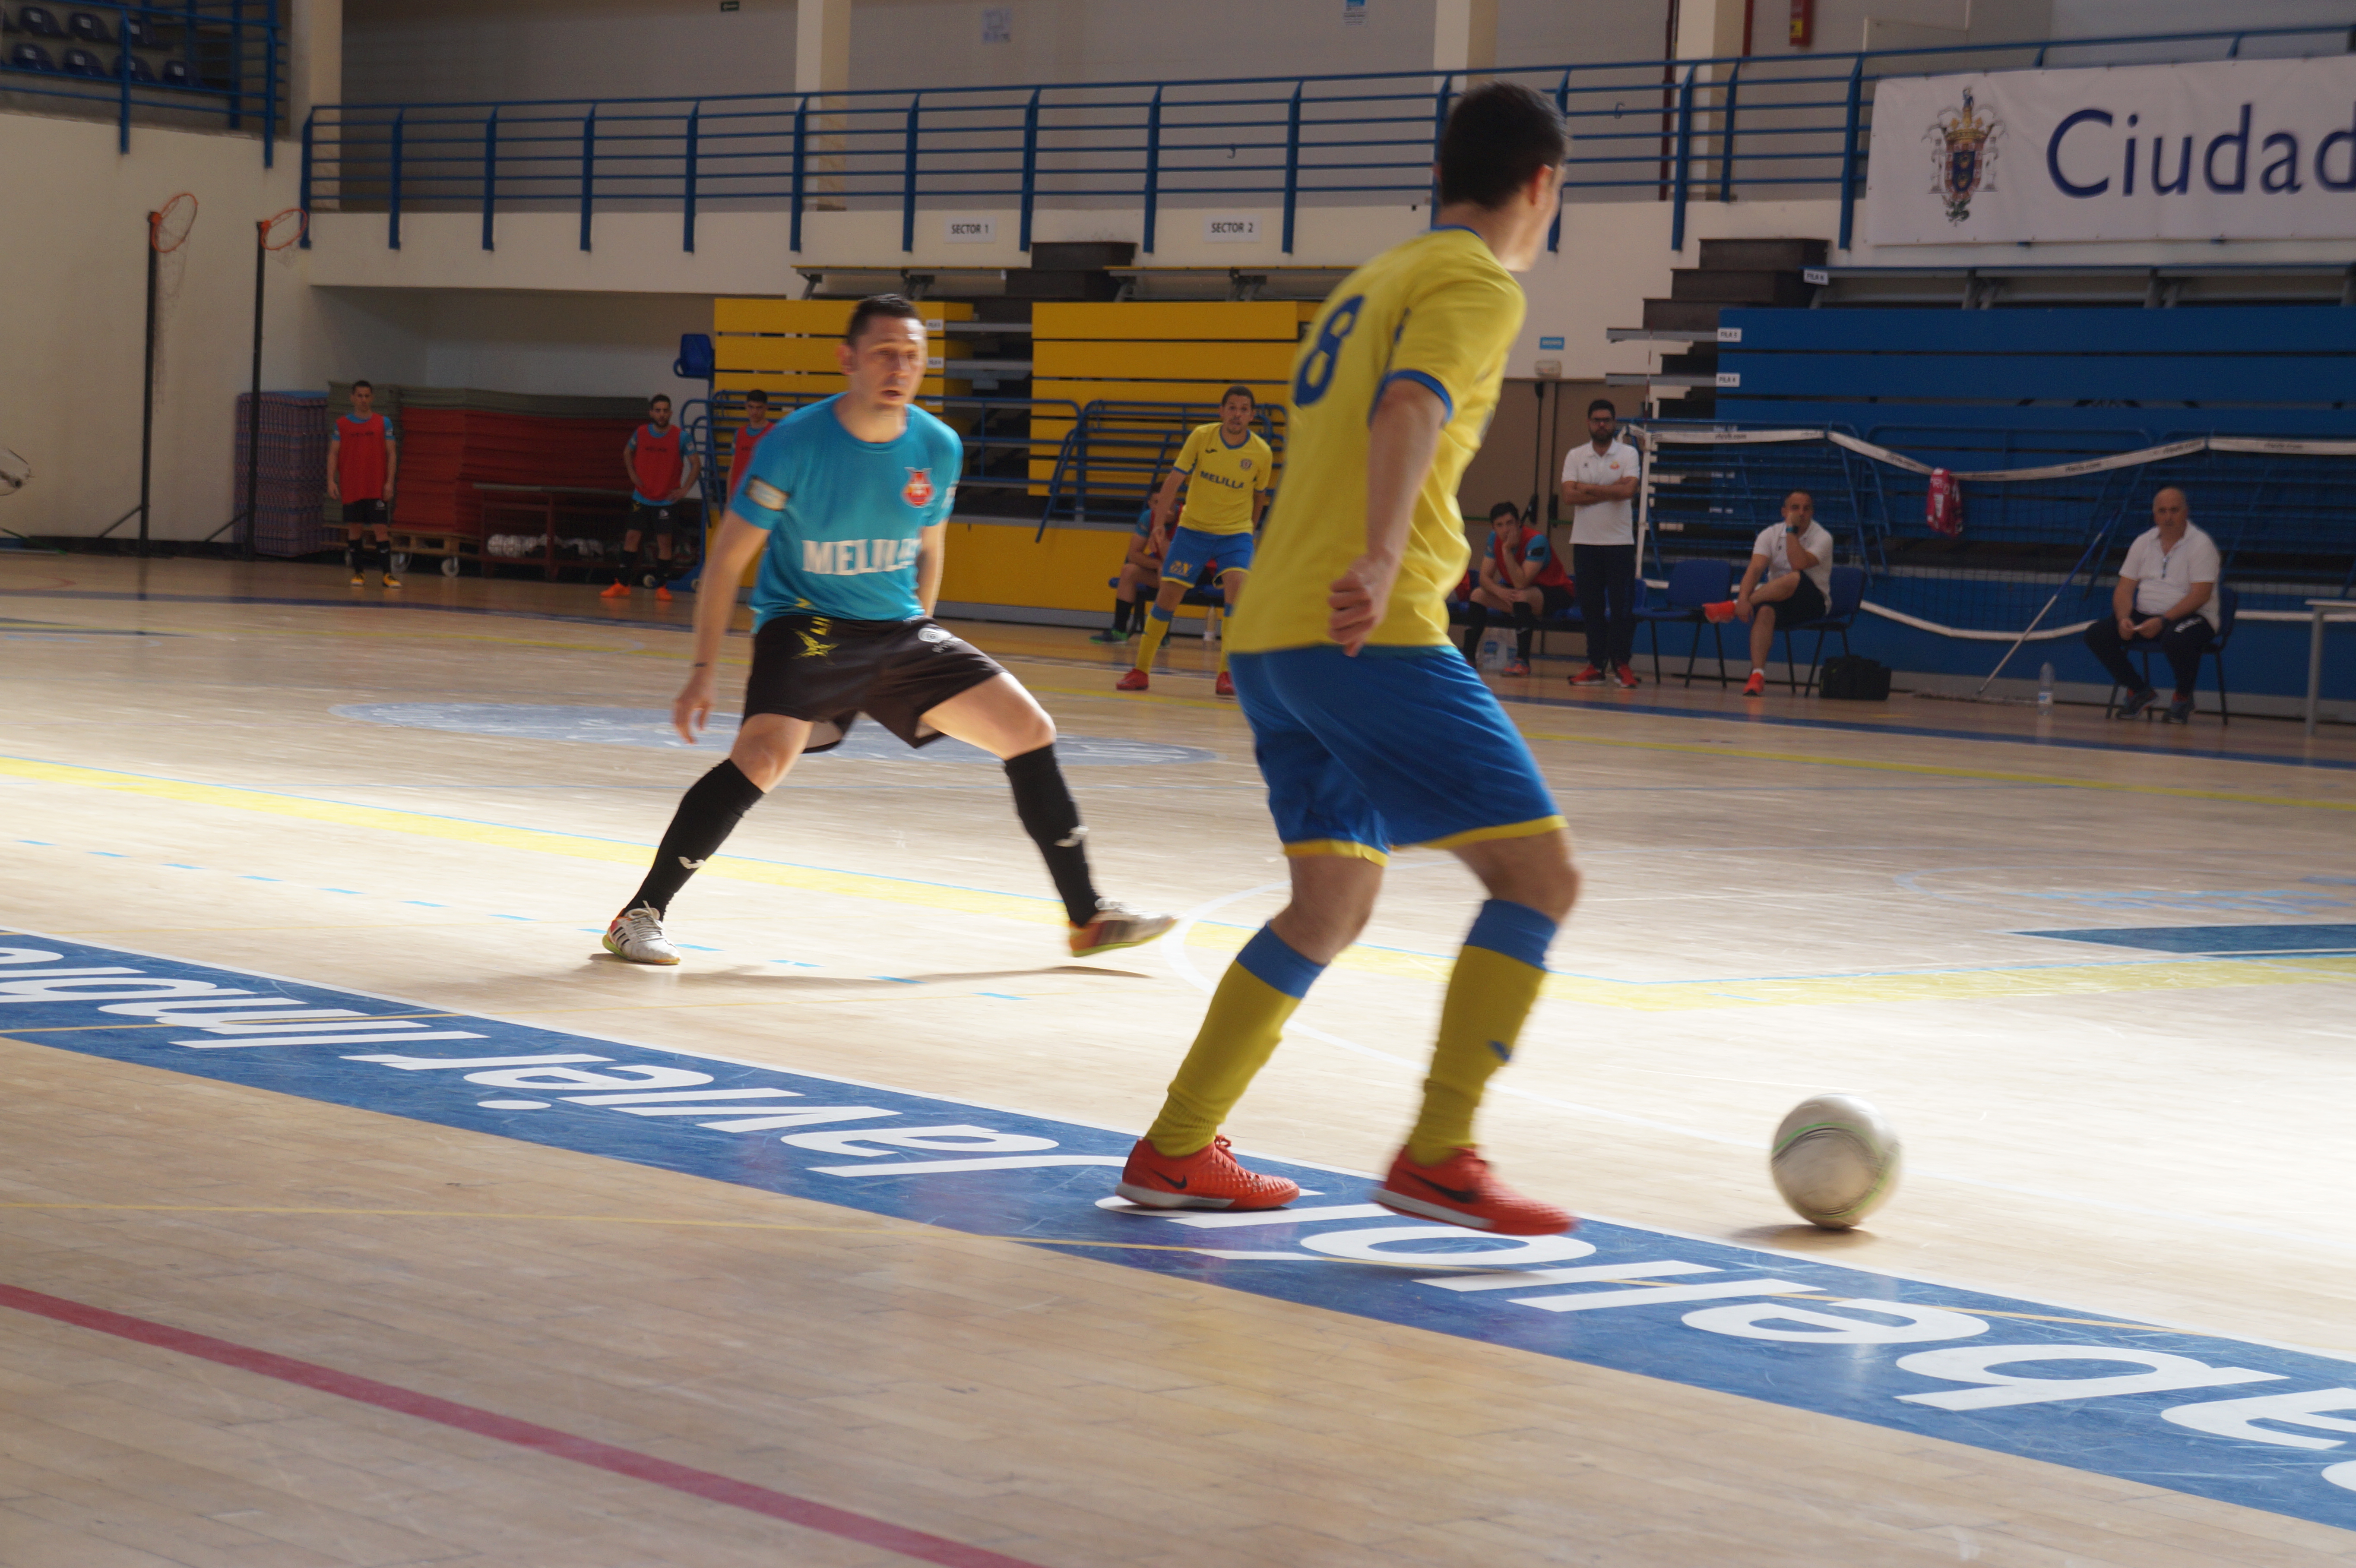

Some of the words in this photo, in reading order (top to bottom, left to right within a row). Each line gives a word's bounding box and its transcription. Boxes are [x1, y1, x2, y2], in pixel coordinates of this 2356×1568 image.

[2046, 102, 2356, 199] Ciudad
[951, 224, 981, 234] SECTOR
[985, 224, 988, 234] 1
[1211, 222, 1244, 233] SECTOR
[1248, 222, 1253, 233] 2
[1293, 294, 1365, 410] 8
[1200, 470, 1244, 489] MELILLA
[338, 1053, 1128, 1177] Javier
[1095, 1188, 2356, 1492] abellón
